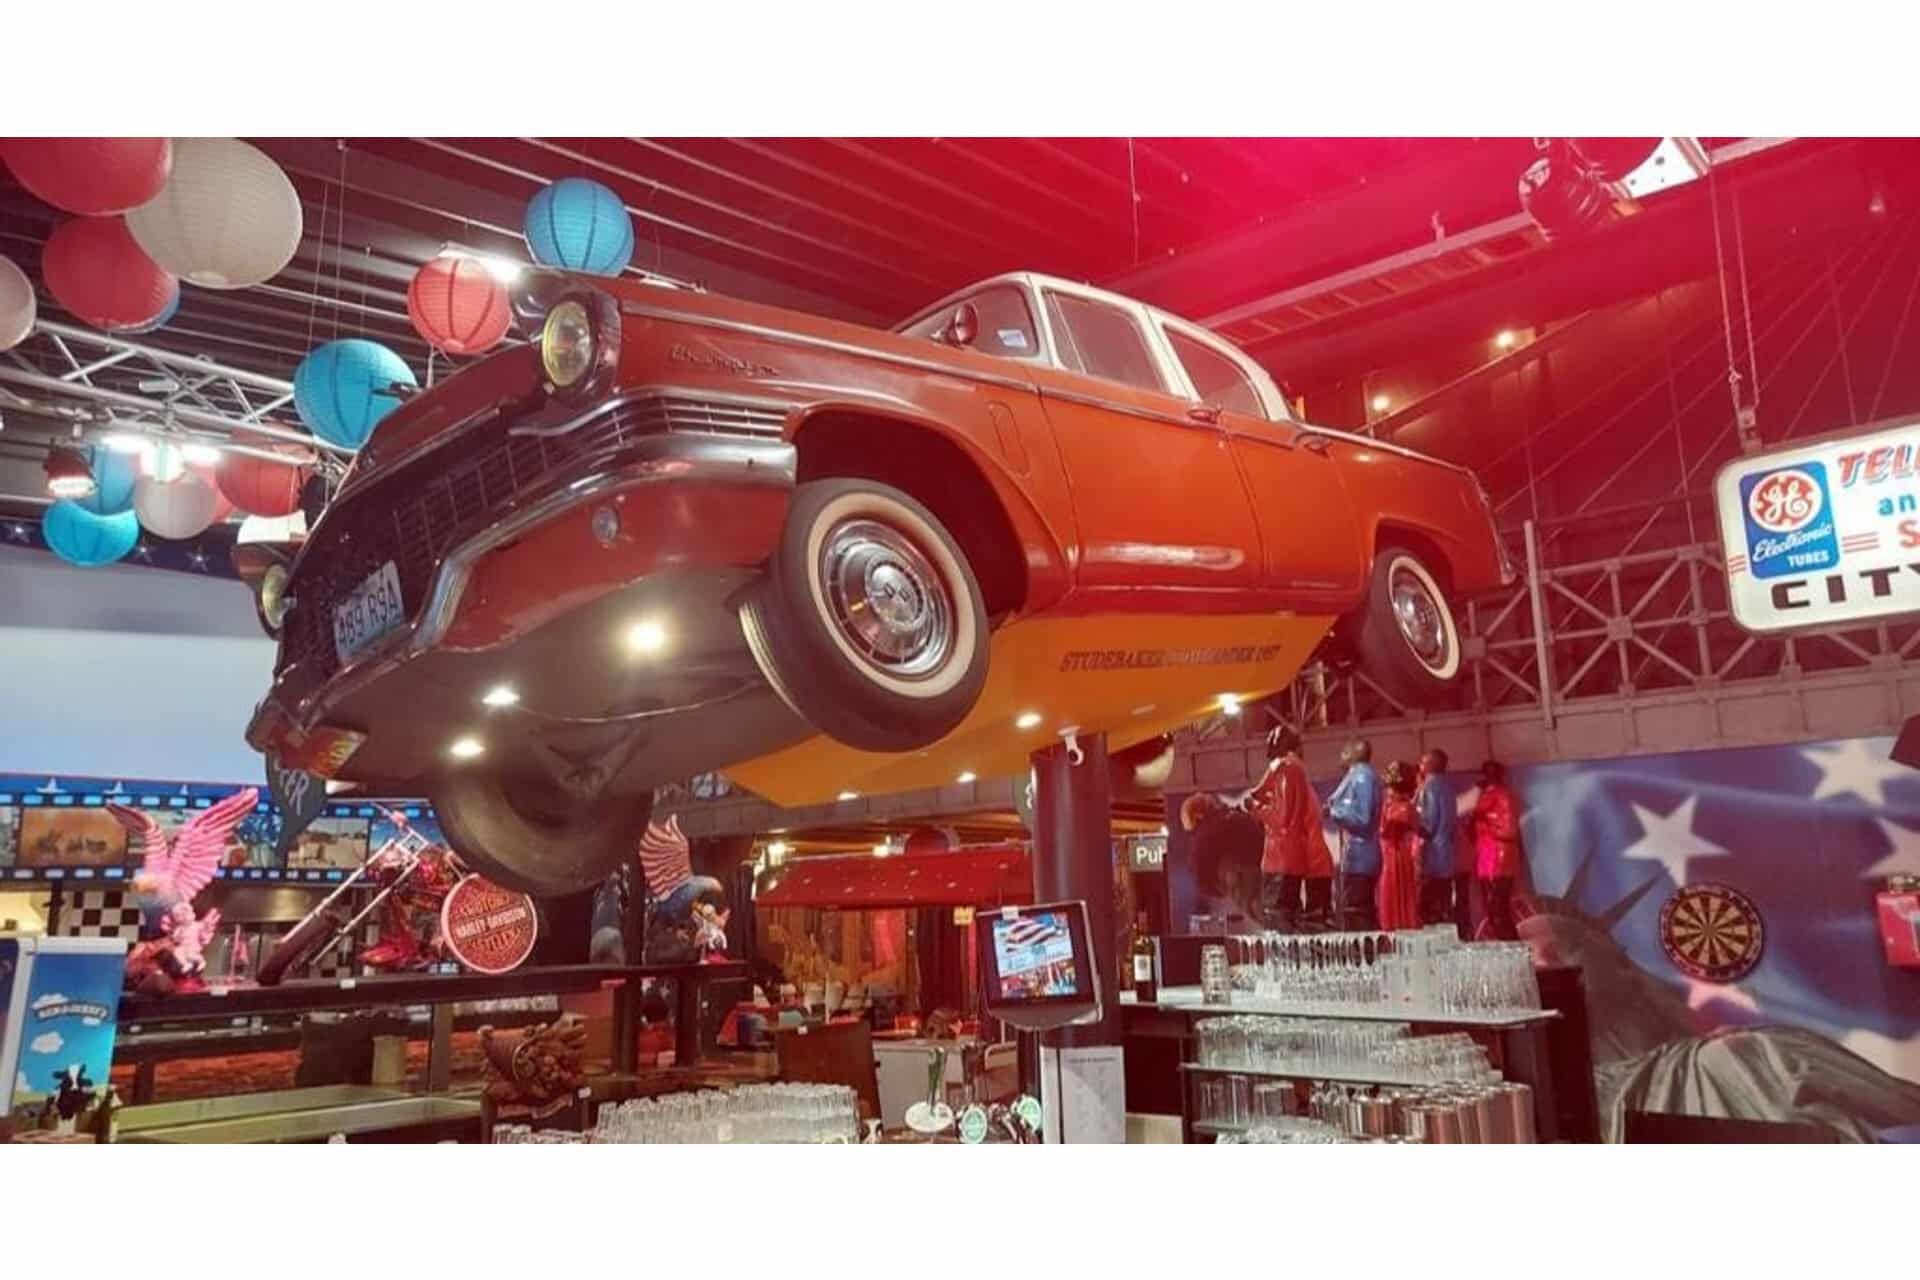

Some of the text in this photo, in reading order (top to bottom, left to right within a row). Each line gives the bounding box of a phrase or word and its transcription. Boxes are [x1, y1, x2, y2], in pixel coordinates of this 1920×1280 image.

[1837, 443, 1920, 488] TEL
[1752, 521, 1833, 562] Electronic
[1787, 549, 1830, 568] TUBES
